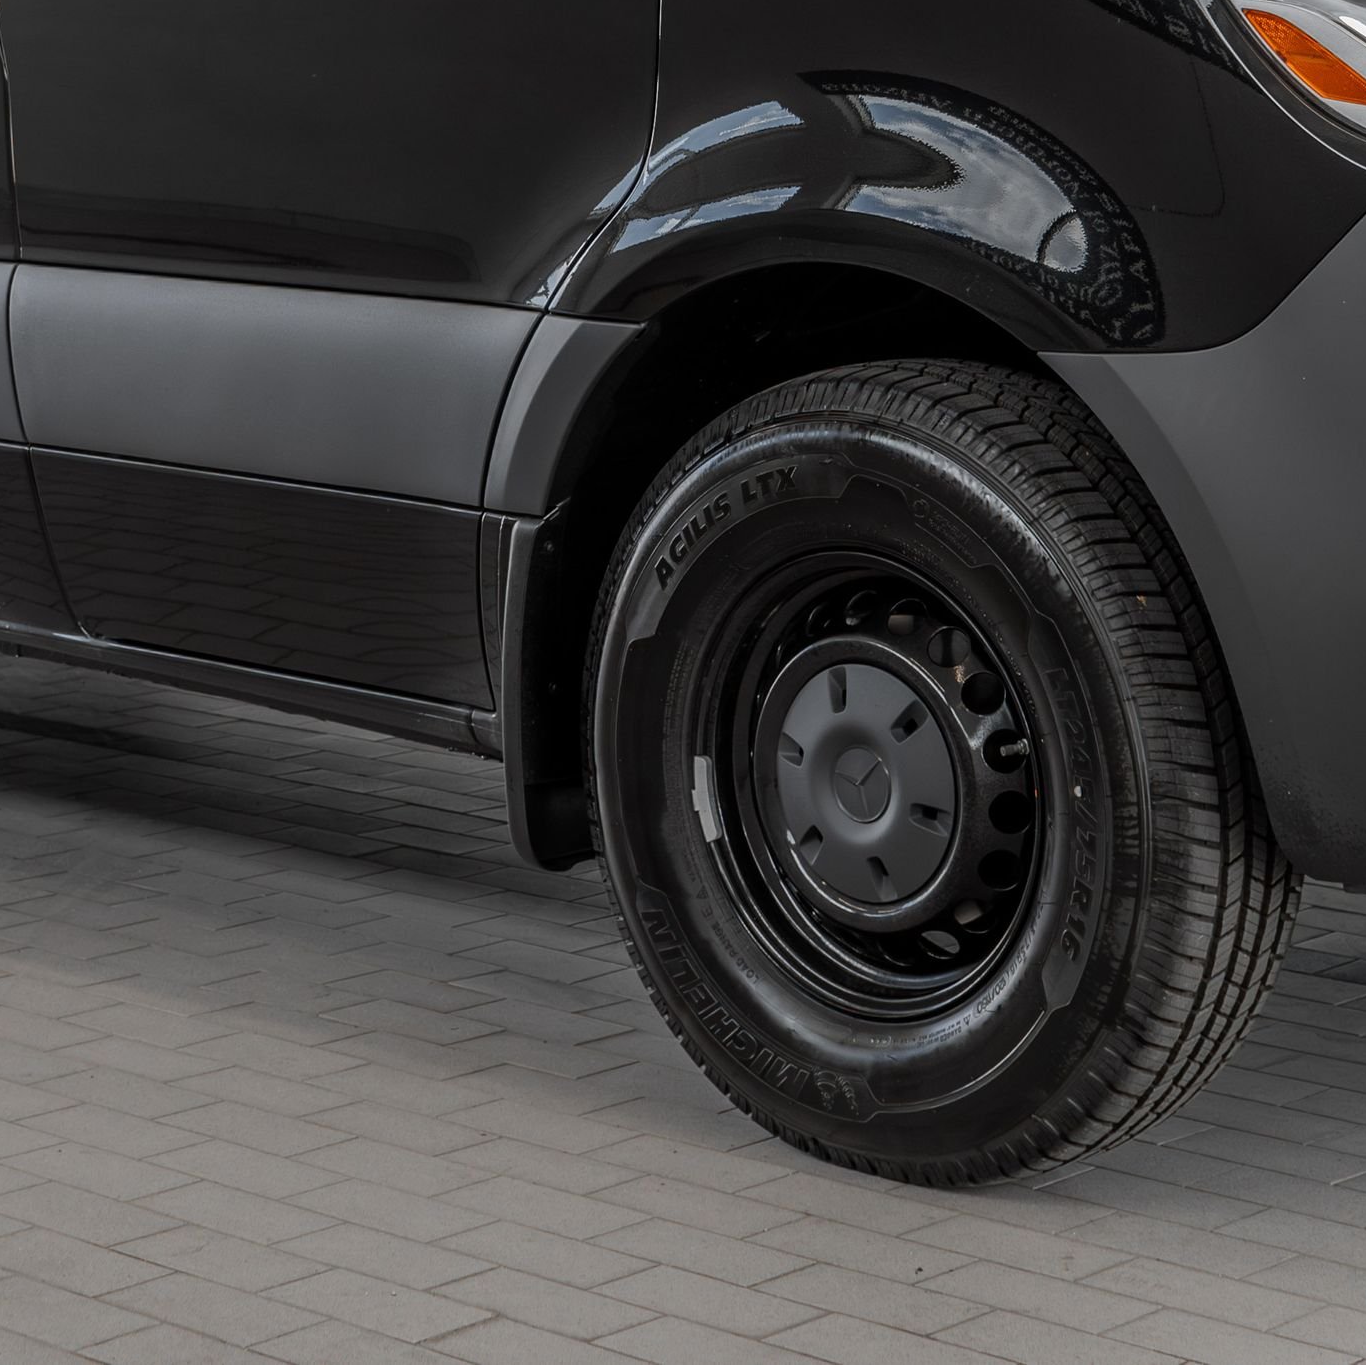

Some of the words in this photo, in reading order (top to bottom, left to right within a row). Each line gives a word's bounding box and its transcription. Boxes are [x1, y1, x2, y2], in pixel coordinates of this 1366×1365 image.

[654, 491, 731, 591] AGILIS
[740, 464, 798, 505] LTX
[640, 909, 811, 1099] MICHELIN
